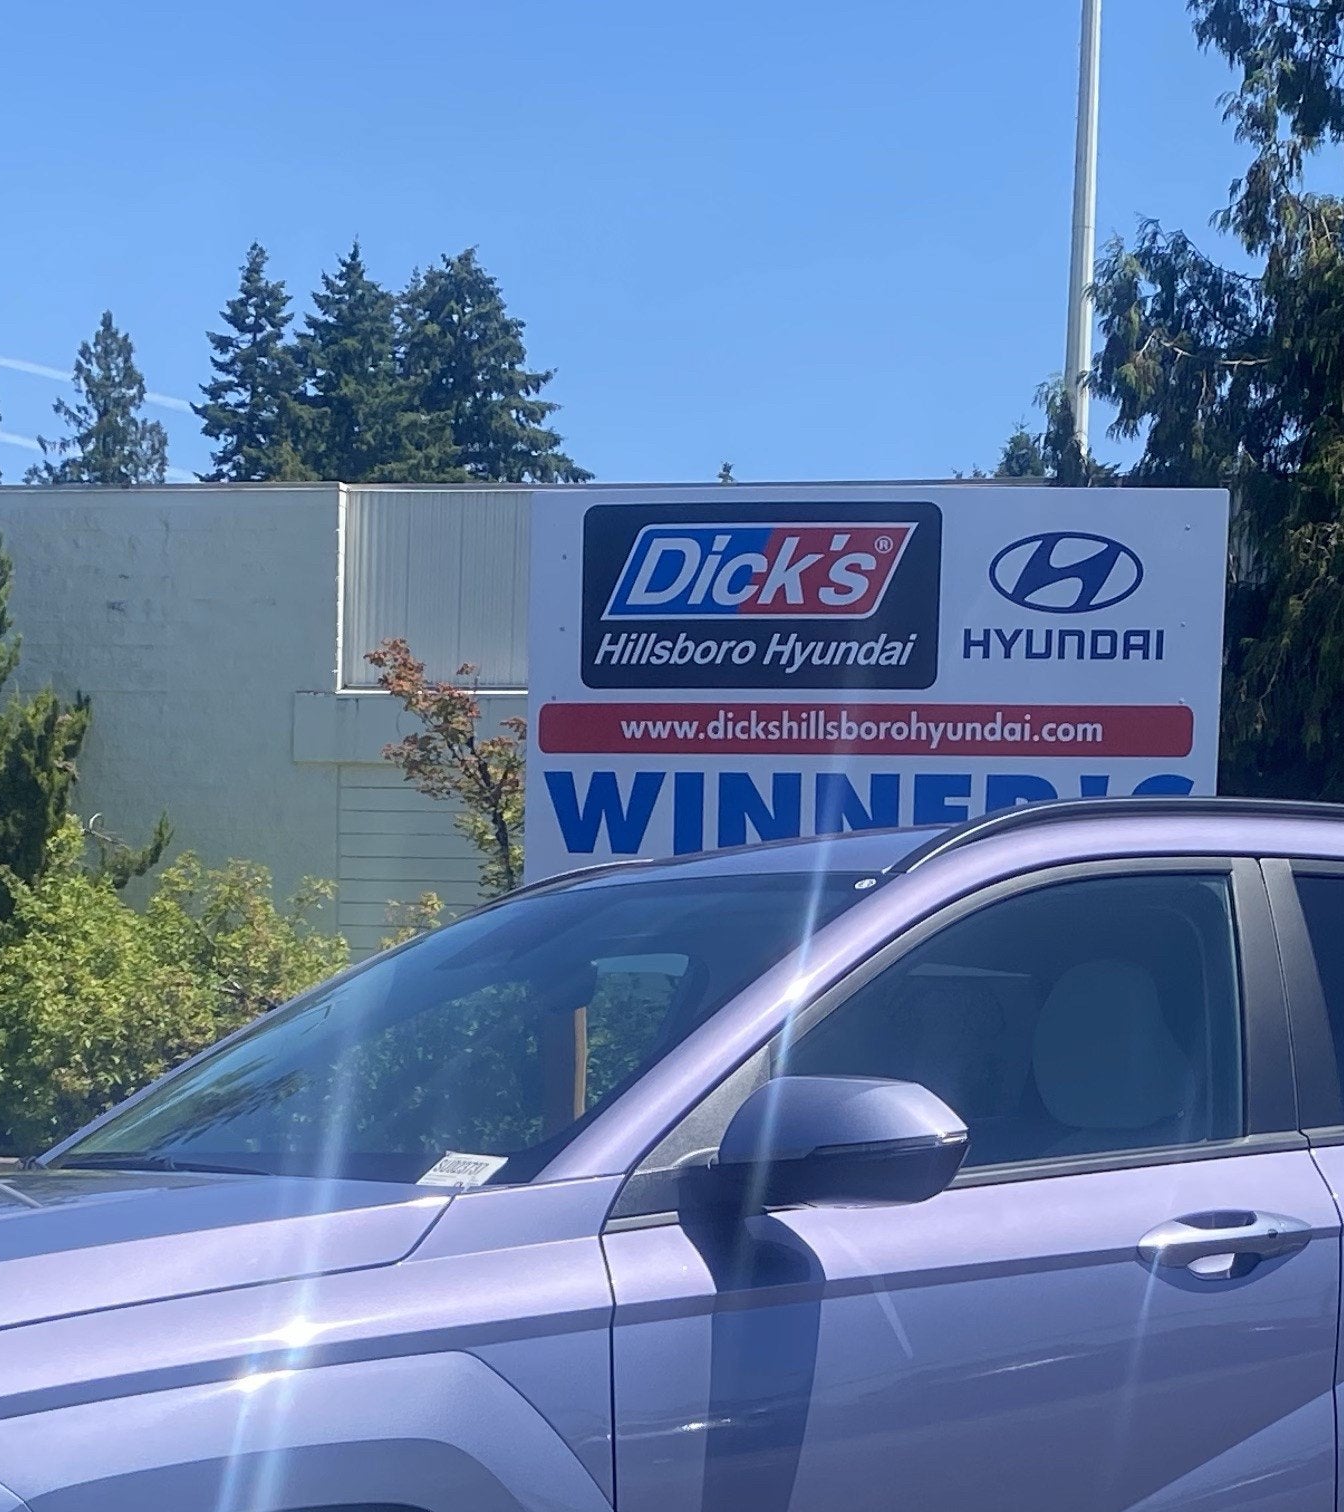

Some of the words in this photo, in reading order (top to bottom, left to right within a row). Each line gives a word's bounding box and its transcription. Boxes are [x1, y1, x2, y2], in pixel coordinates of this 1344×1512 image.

[594, 632, 757, 667] Hillsboro
[762, 632, 918, 674] Hyundai
[962, 628, 1165, 661] HYUNDAI
[620, 711, 1104, 750] www.dickshillsborohyundai.com
[544, 771, 1195, 856] WINNE'
